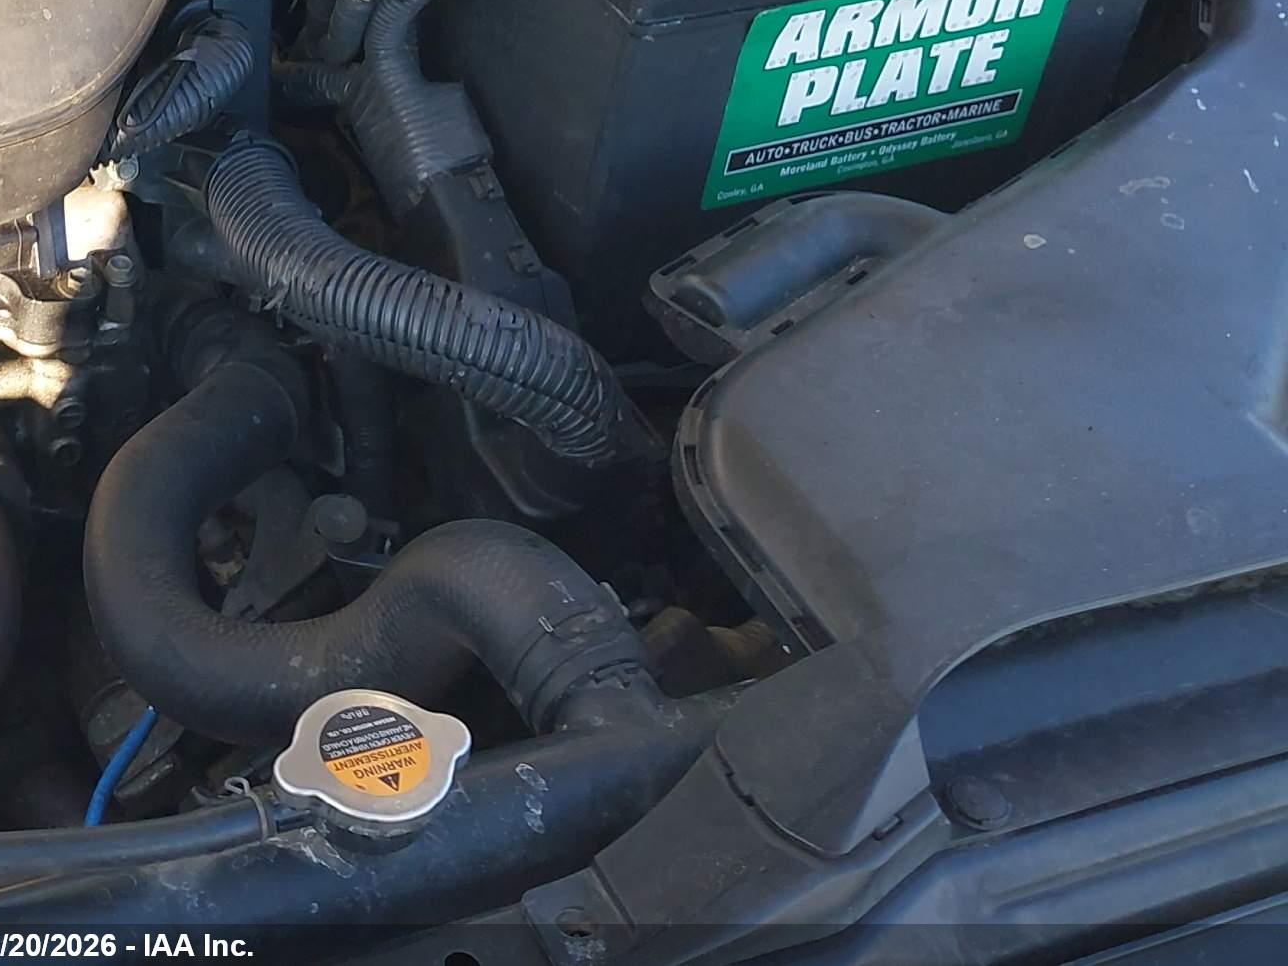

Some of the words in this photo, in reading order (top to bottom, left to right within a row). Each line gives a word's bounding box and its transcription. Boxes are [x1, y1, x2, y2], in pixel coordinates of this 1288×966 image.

[777, 28, 1011, 127] PLATE
[779, 159, 828, 177] Moreland
[830, 149, 867, 166] Battery
[920, 132, 957, 147] Battery
[333, 740, 422, 772] AVERTISSEMENT
[352, 755, 417, 779] WARNING
